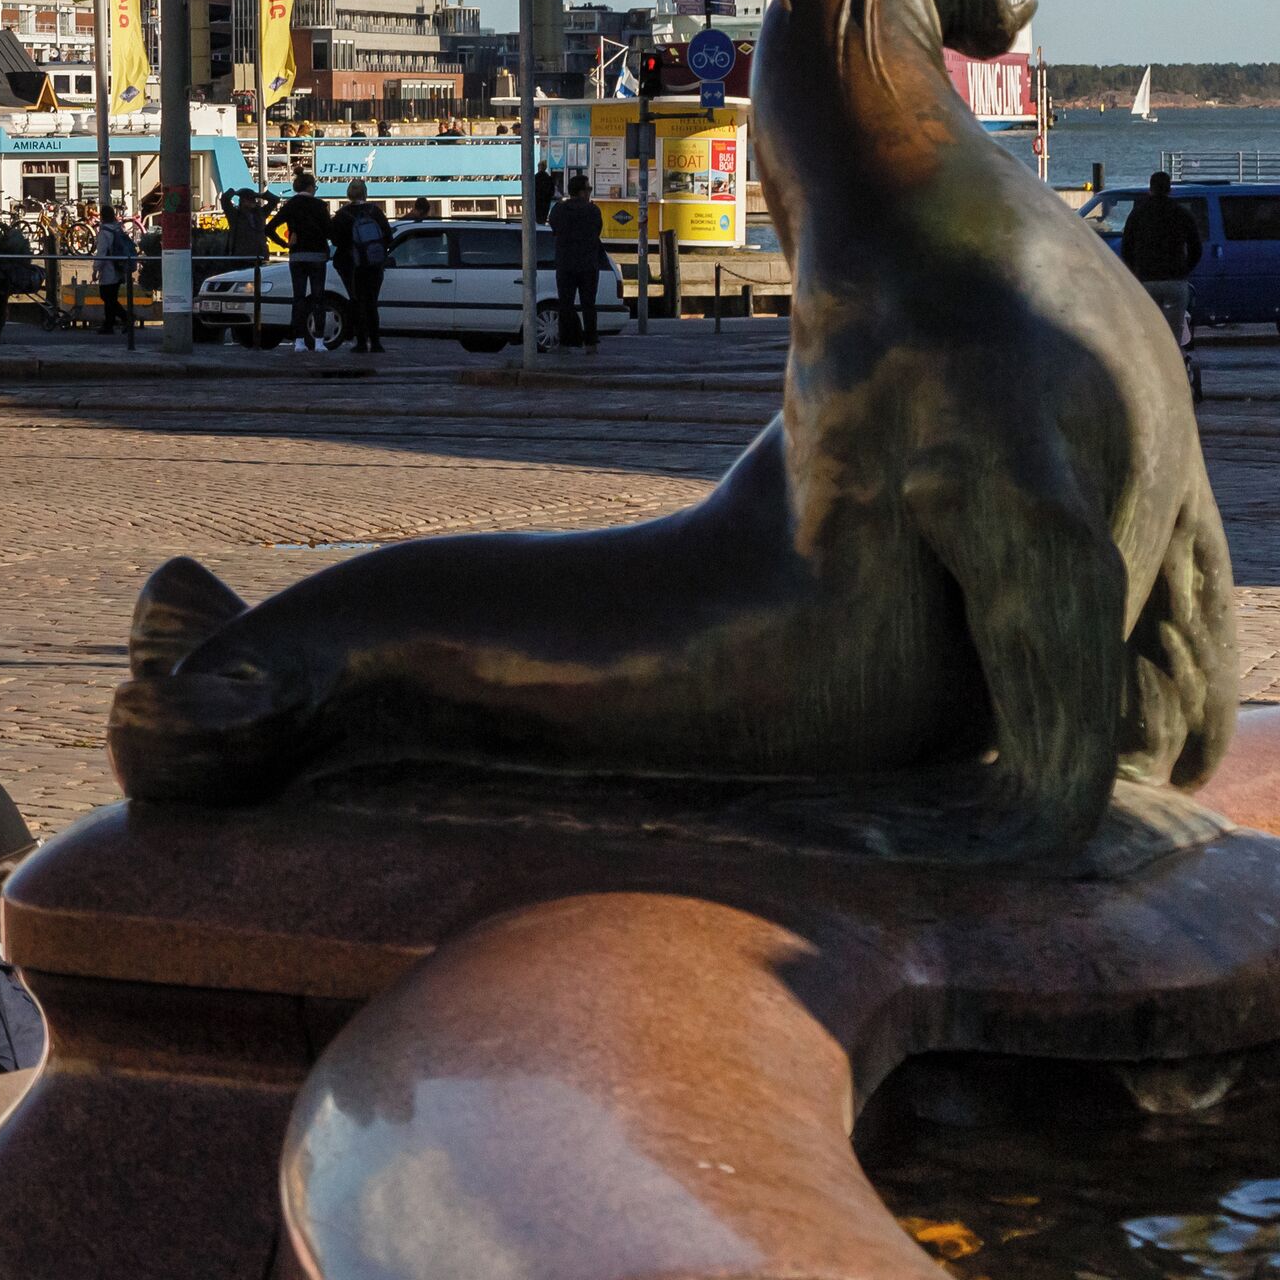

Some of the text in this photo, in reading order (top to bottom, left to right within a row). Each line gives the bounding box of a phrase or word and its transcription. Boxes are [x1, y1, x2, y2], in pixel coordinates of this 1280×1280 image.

[967, 62, 1023, 115] VIKING LINE
[13, 141, 62, 150] AMIRAALI
[667, 154, 705, 169] BOAT
[320, 163, 368, 174] JT-LINE
